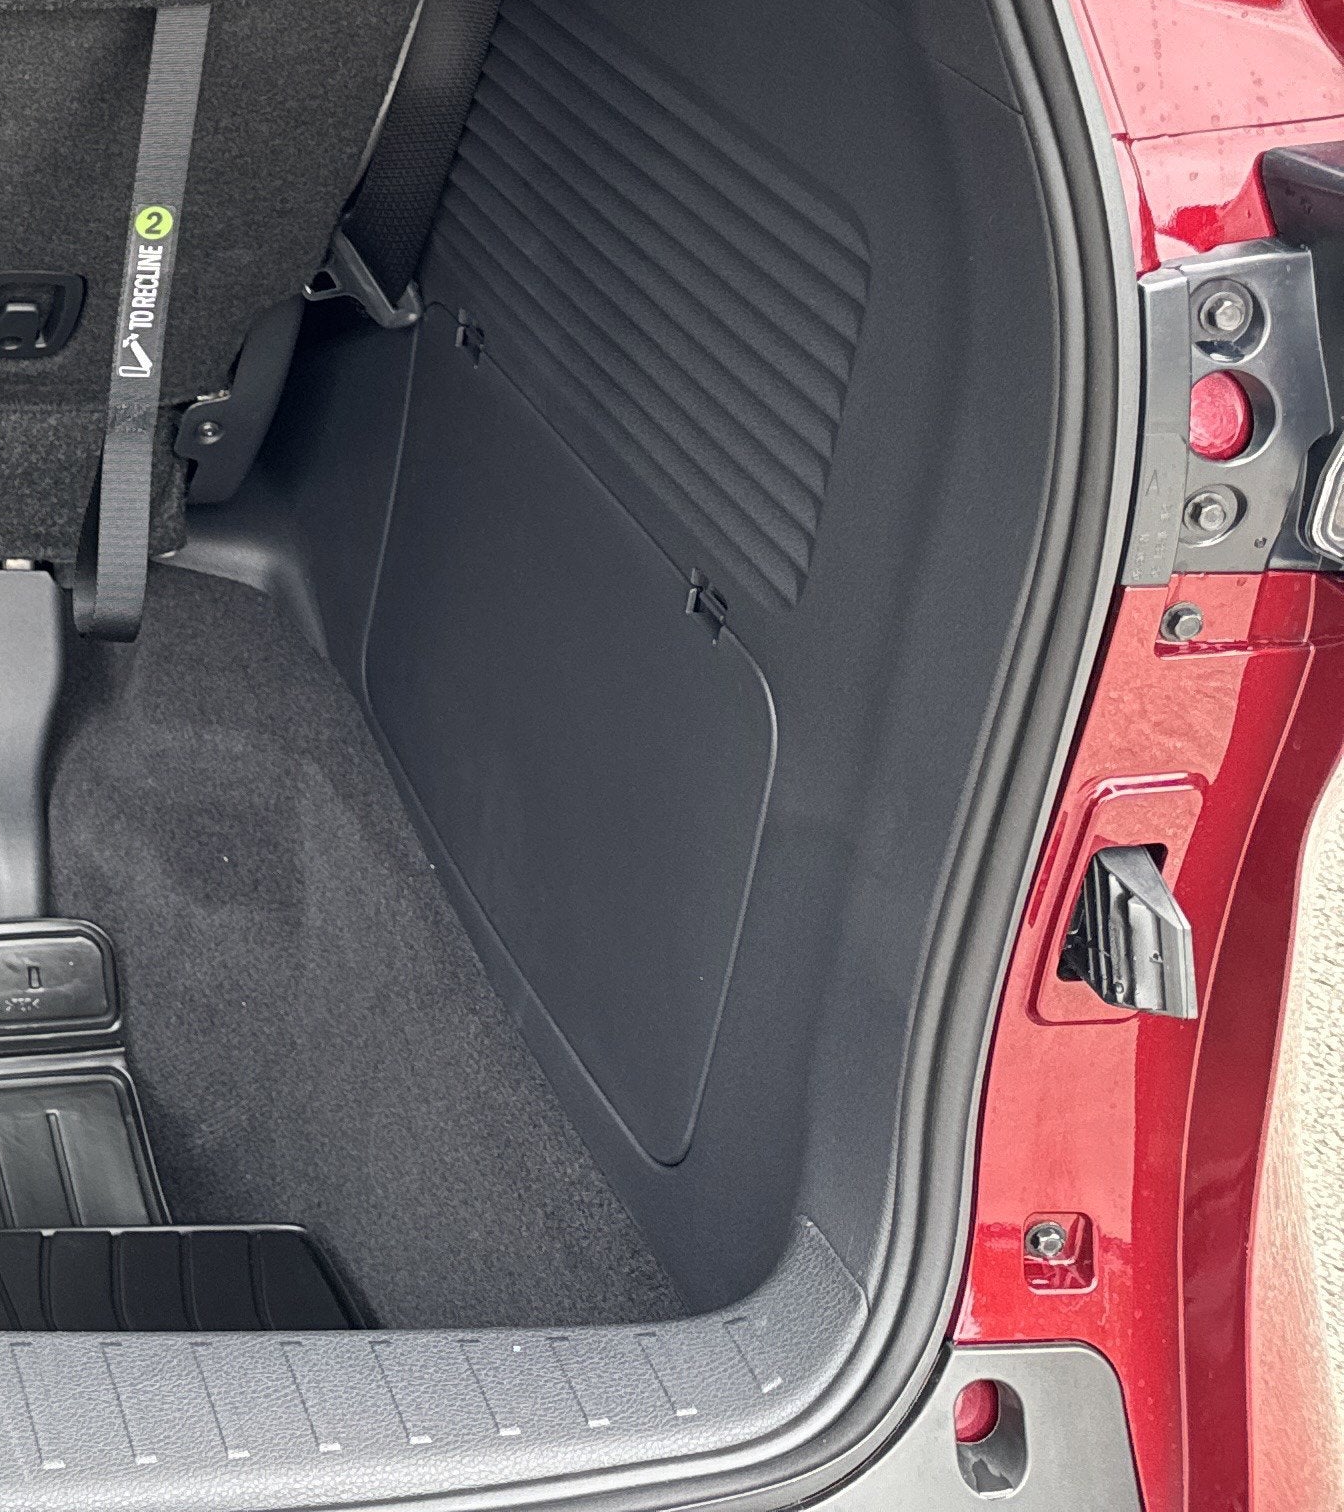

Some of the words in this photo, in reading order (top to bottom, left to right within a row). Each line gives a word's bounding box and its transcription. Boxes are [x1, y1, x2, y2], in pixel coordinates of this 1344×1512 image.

[145, 211, 163, 235] 2
[132, 244, 163, 308] RECLINE
[129, 310, 154, 330] TO
